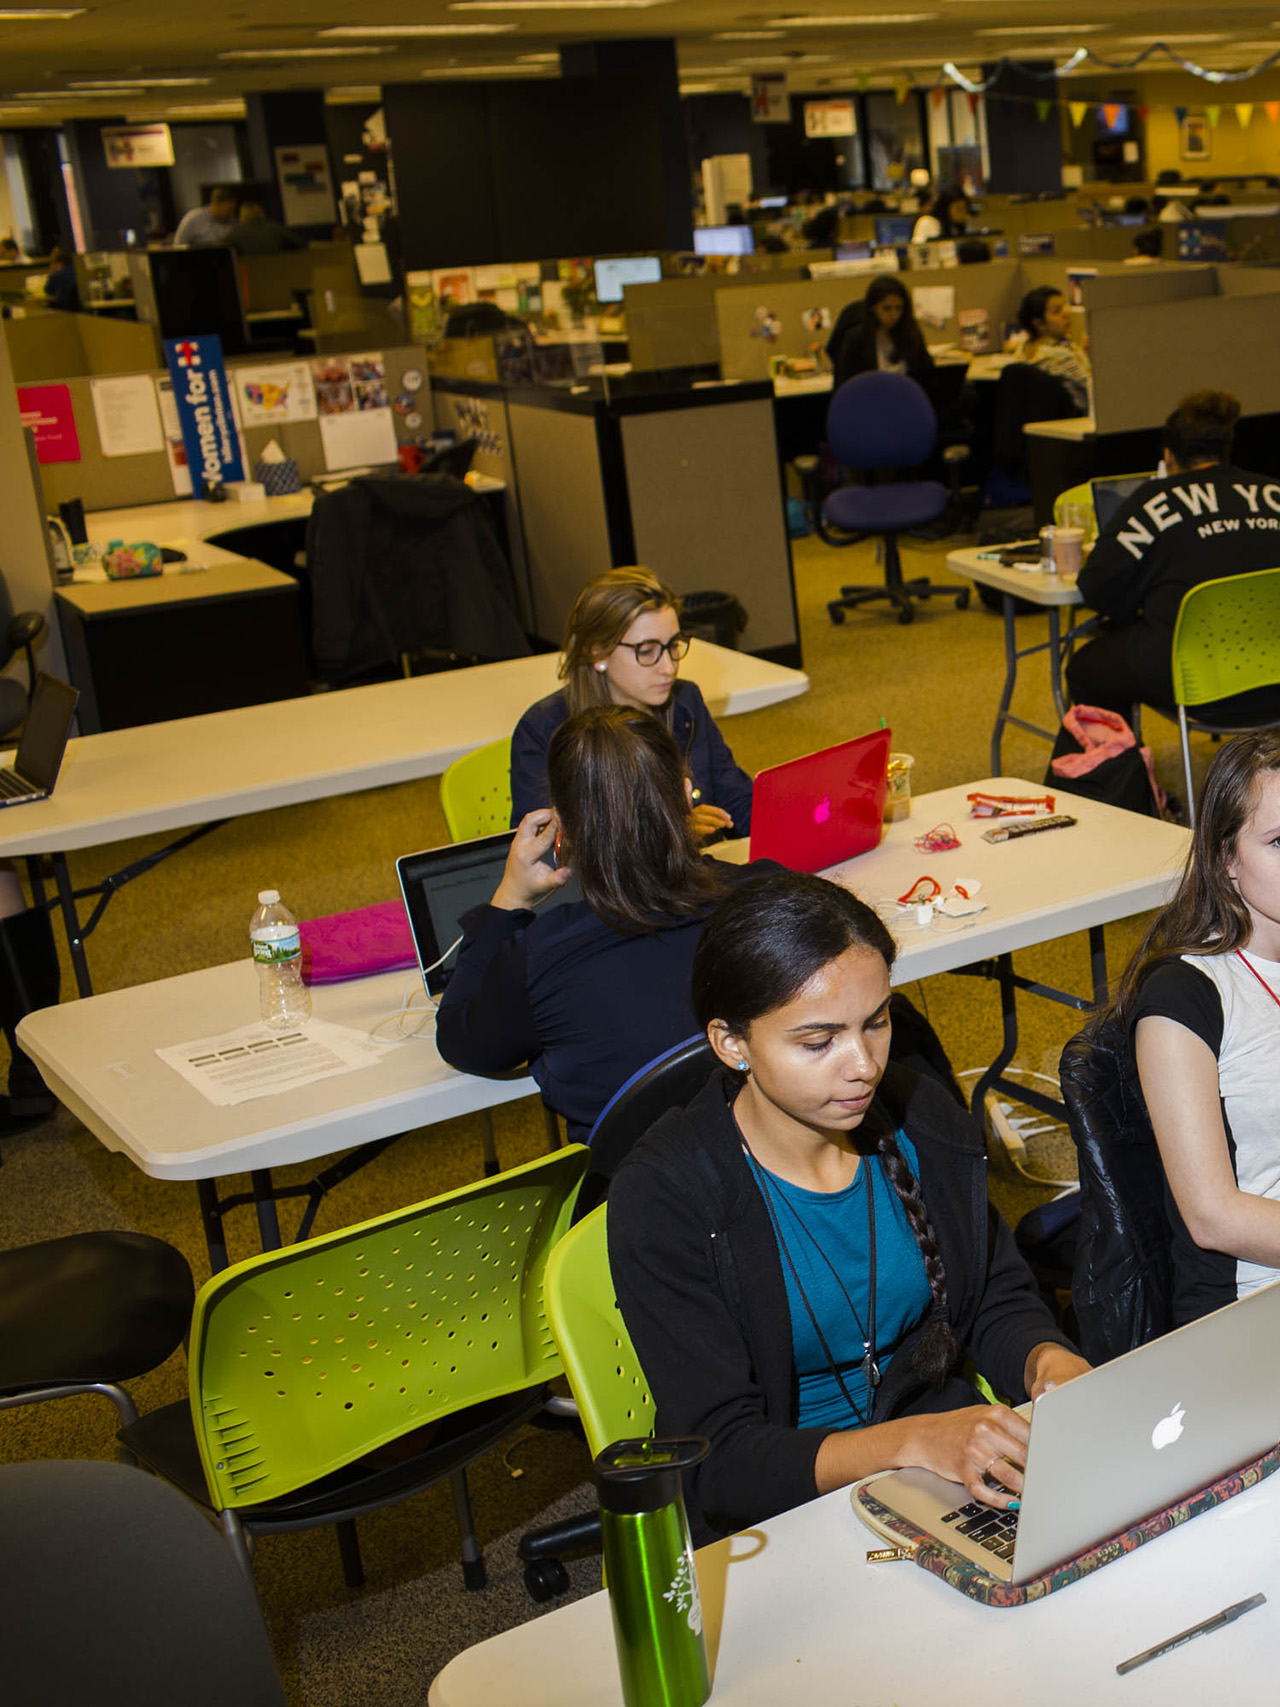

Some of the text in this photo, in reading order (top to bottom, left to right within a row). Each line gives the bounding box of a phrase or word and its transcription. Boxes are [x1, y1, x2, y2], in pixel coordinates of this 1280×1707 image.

[185, 368, 208, 406] for
[1116, 482, 1220, 560] NEW
[1197, 519, 1240, 539] NEW
